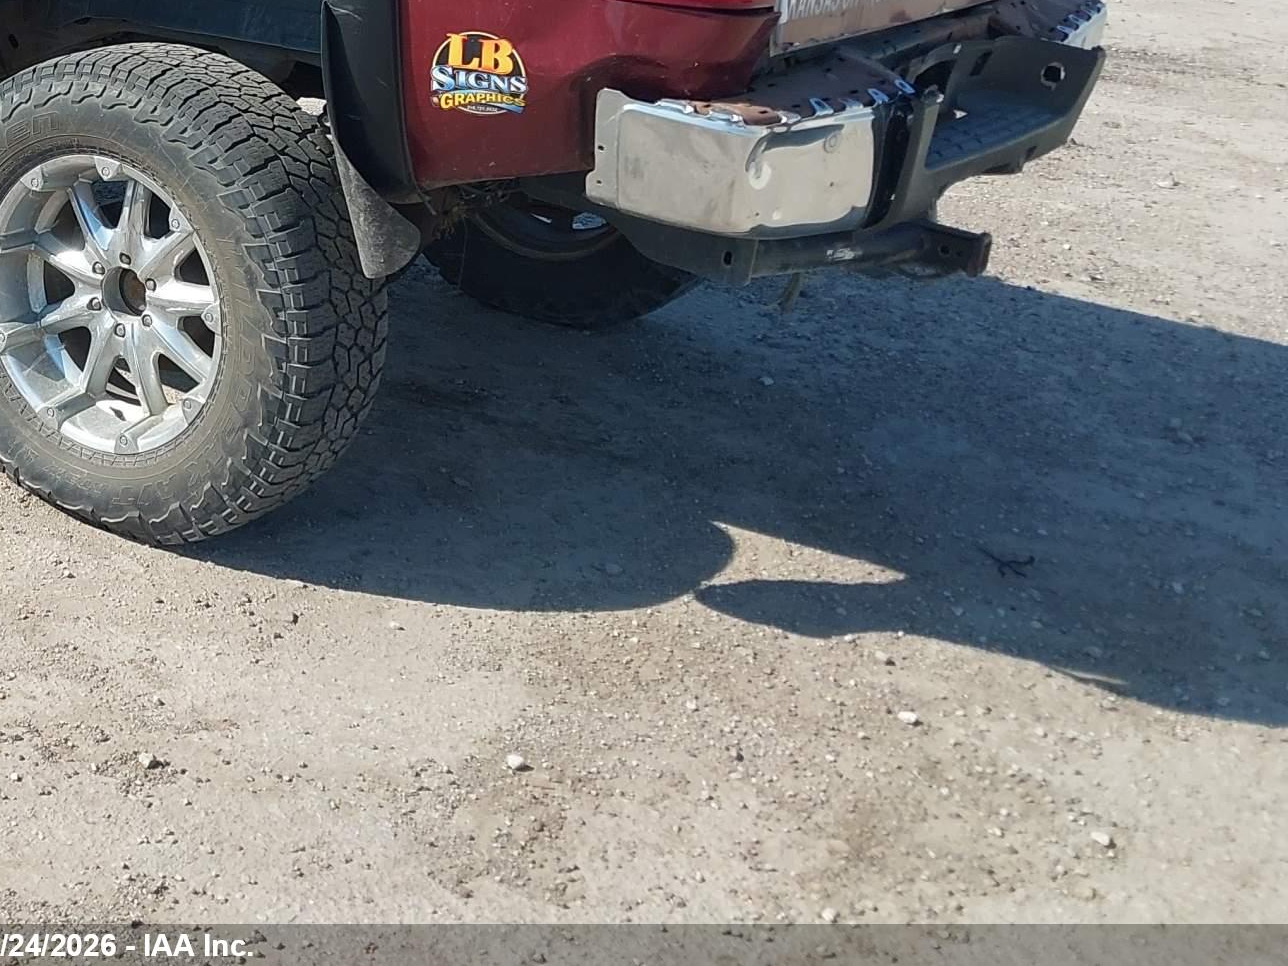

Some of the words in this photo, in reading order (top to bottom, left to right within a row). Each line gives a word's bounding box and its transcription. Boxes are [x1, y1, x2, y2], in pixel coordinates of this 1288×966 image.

[446, 33, 514, 75] LB
[430, 64, 528, 94] SIGNS
[439, 91, 527, 110] GRAPHICS
